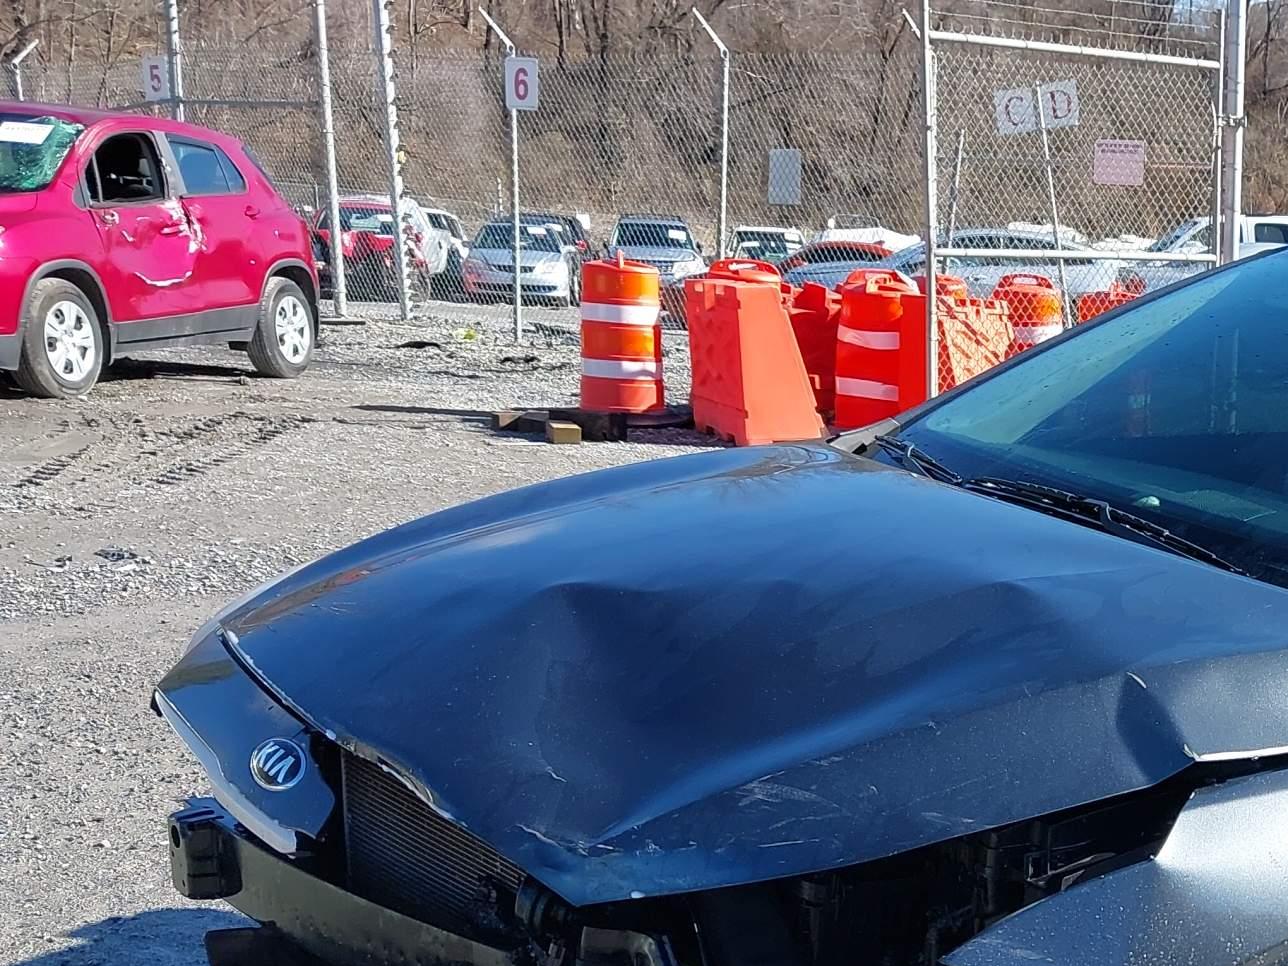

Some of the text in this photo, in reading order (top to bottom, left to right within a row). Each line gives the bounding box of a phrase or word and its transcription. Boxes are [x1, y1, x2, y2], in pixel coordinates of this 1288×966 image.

[150, 65, 161, 92] 5
[514, 67, 528, 100] 6
[1004, 96, 1026, 126] C
[1048, 90, 1072, 119] D
[255, 741, 295, 783] KIA
